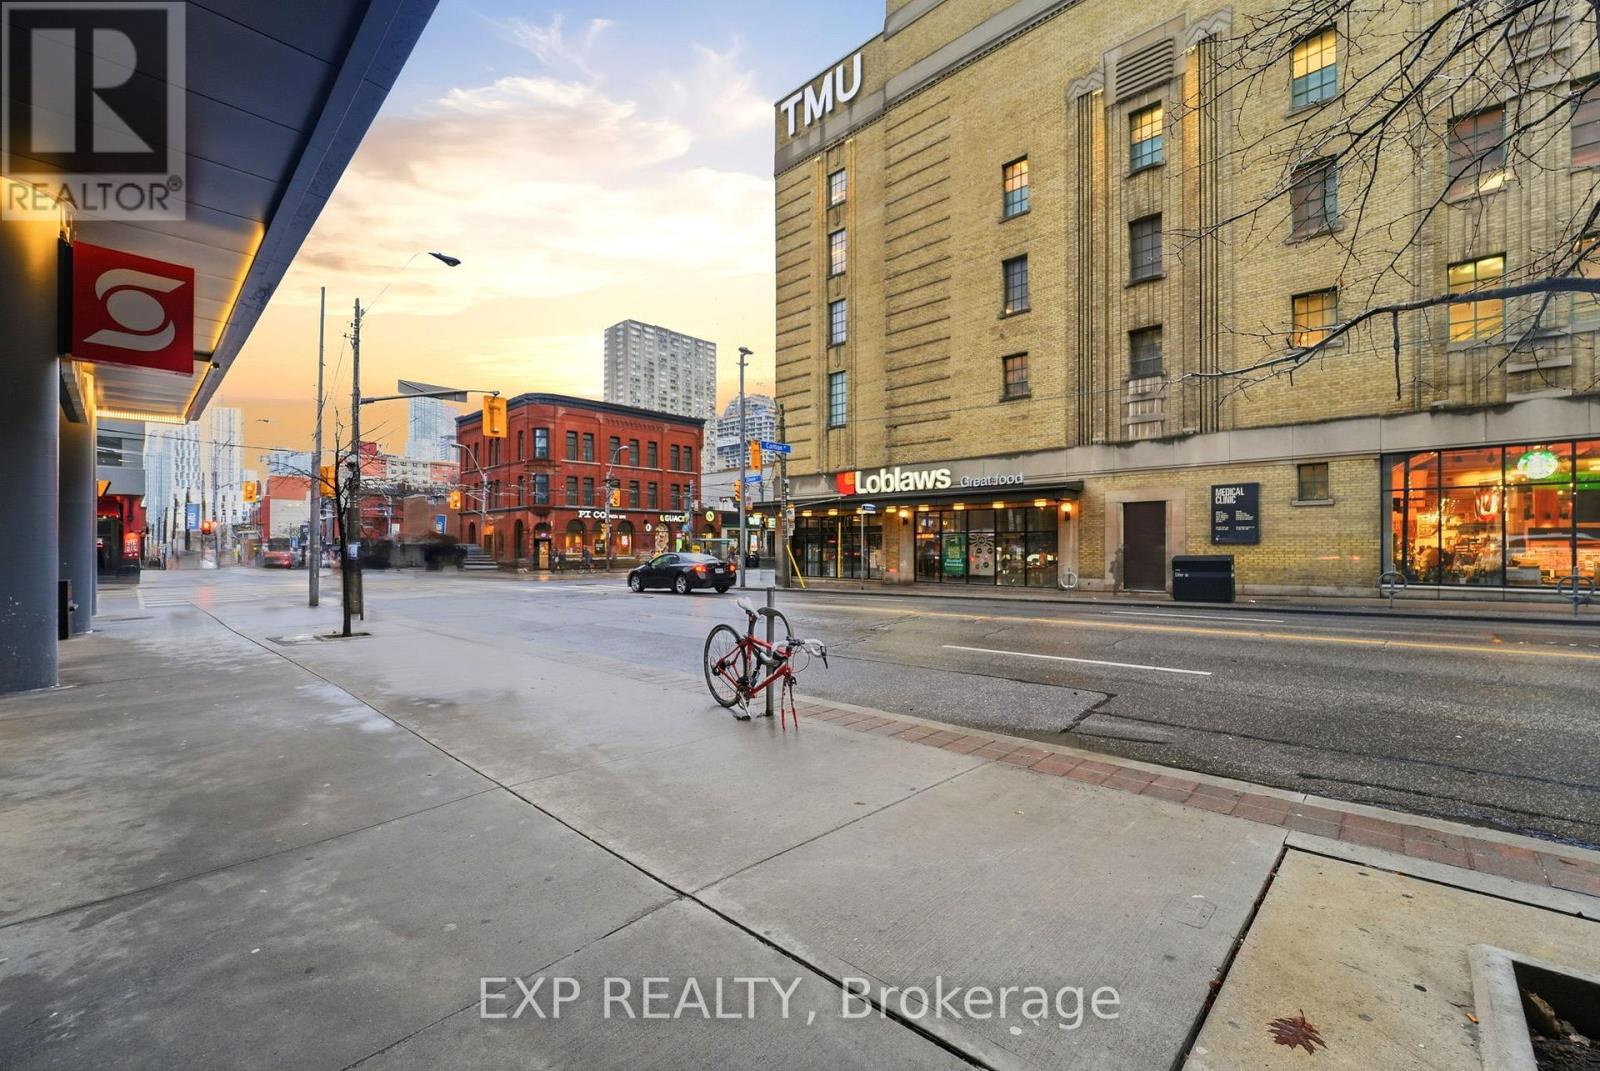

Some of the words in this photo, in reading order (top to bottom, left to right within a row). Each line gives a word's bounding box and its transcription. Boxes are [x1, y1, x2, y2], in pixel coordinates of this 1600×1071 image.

[781, 52, 861, 136] TMU
[855, 467, 951, 494] Loblaws
[960, 474, 992, 488] Great
[995, 472, 1024, 486] food
[1215, 487, 1245, 497] MEDICAL
[1215, 495, 1236, 504] CLINIC
[578, 510, 591, 518] PI
[593, 511, 607, 519] CO
